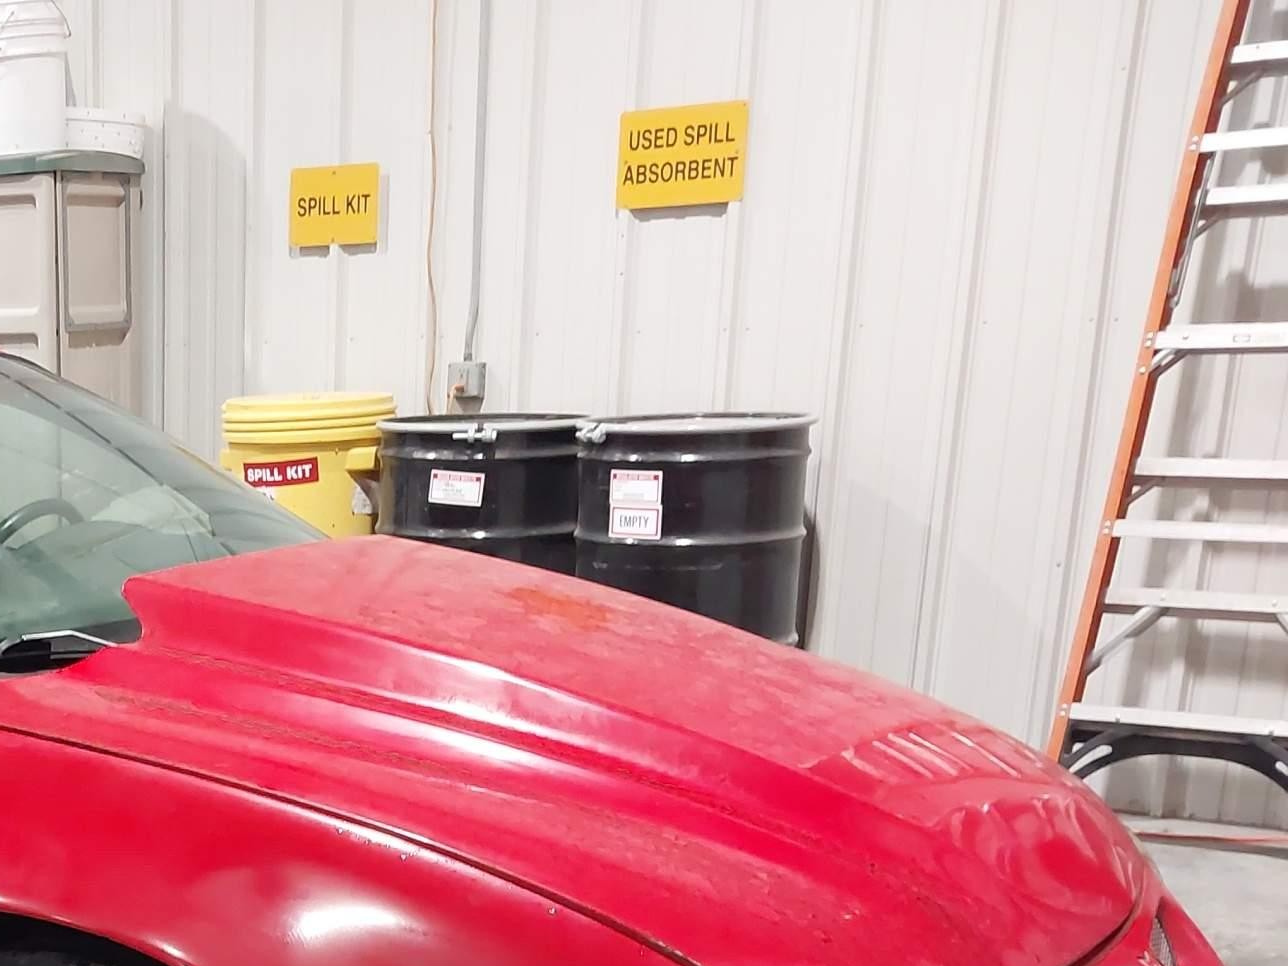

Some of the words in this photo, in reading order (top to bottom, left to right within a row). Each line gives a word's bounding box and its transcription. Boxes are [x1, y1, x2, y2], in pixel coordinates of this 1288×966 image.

[629, 127, 678, 151] USED
[683, 121, 736, 146] SPILL
[622, 156, 739, 186] ABSORBENT
[297, 195, 340, 217] SPILL
[346, 194, 371, 214] KIT
[247, 467, 283, 482] SPILL
[286, 464, 313, 480] KIT
[619, 514, 650, 529] EMPTY
